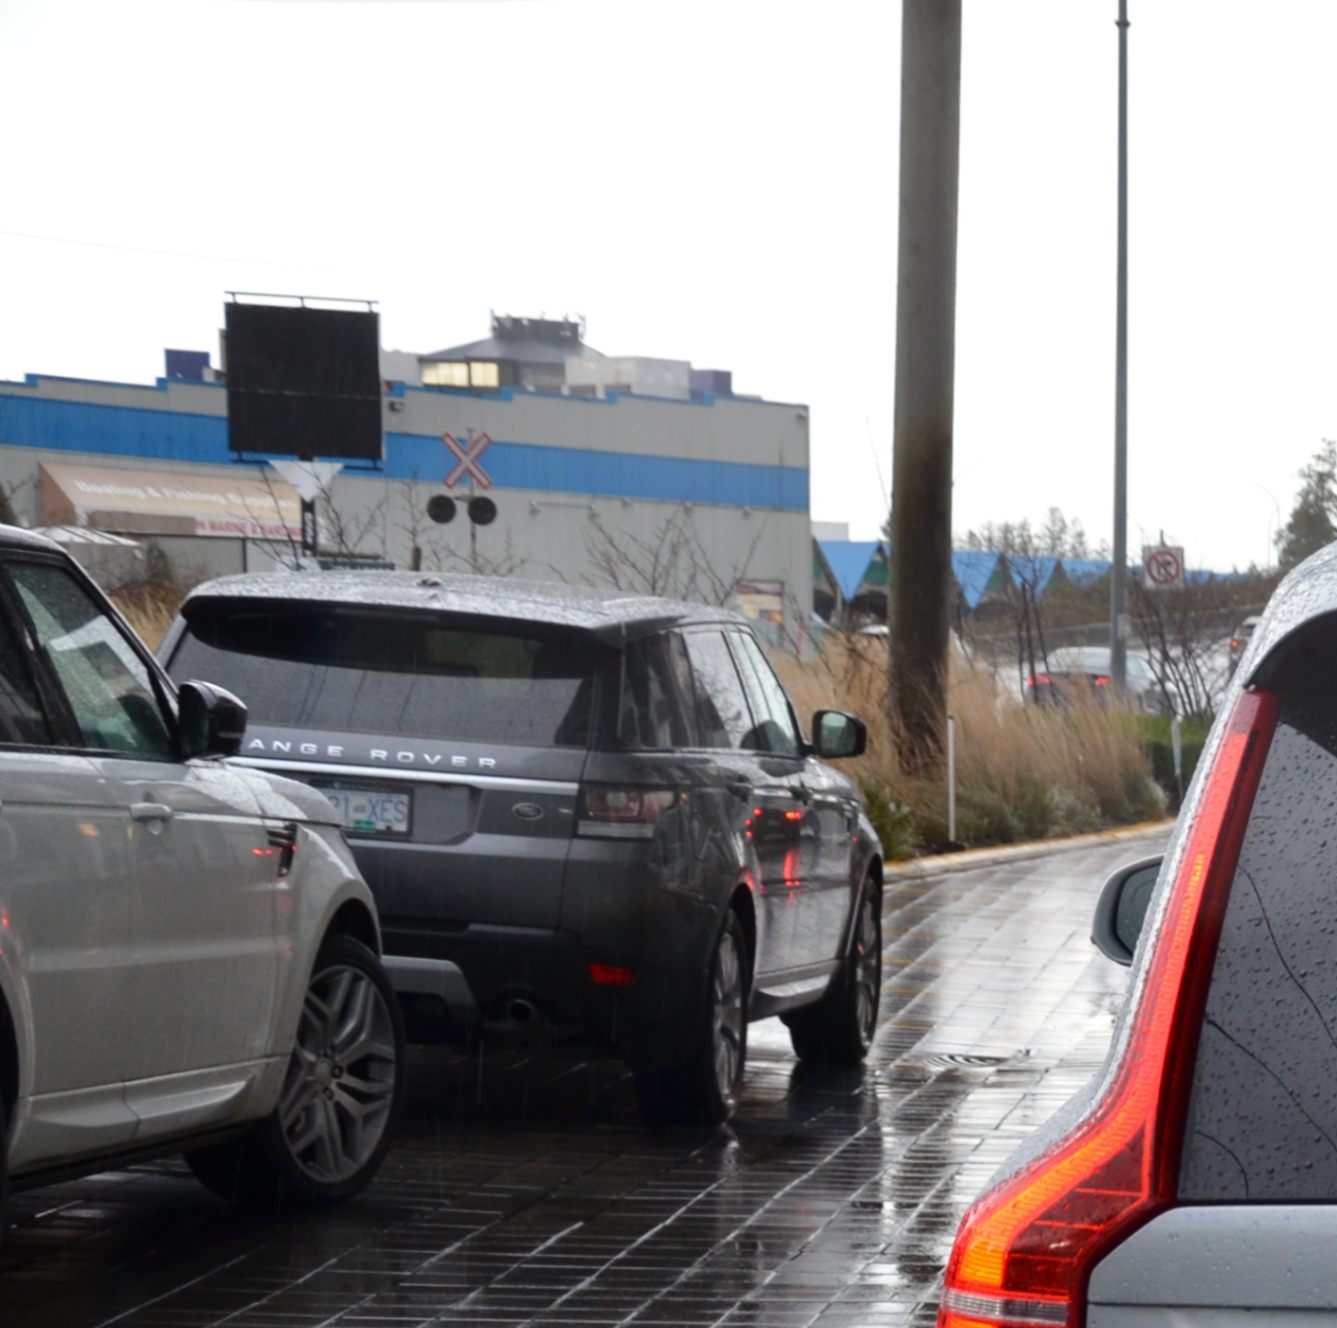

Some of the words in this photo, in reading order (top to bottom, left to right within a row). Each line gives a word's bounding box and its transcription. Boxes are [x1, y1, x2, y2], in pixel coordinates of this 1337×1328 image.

[248, 739, 344, 757] ANGE
[370, 749, 497, 769] ROVER
[367, 797, 408, 823] XES
